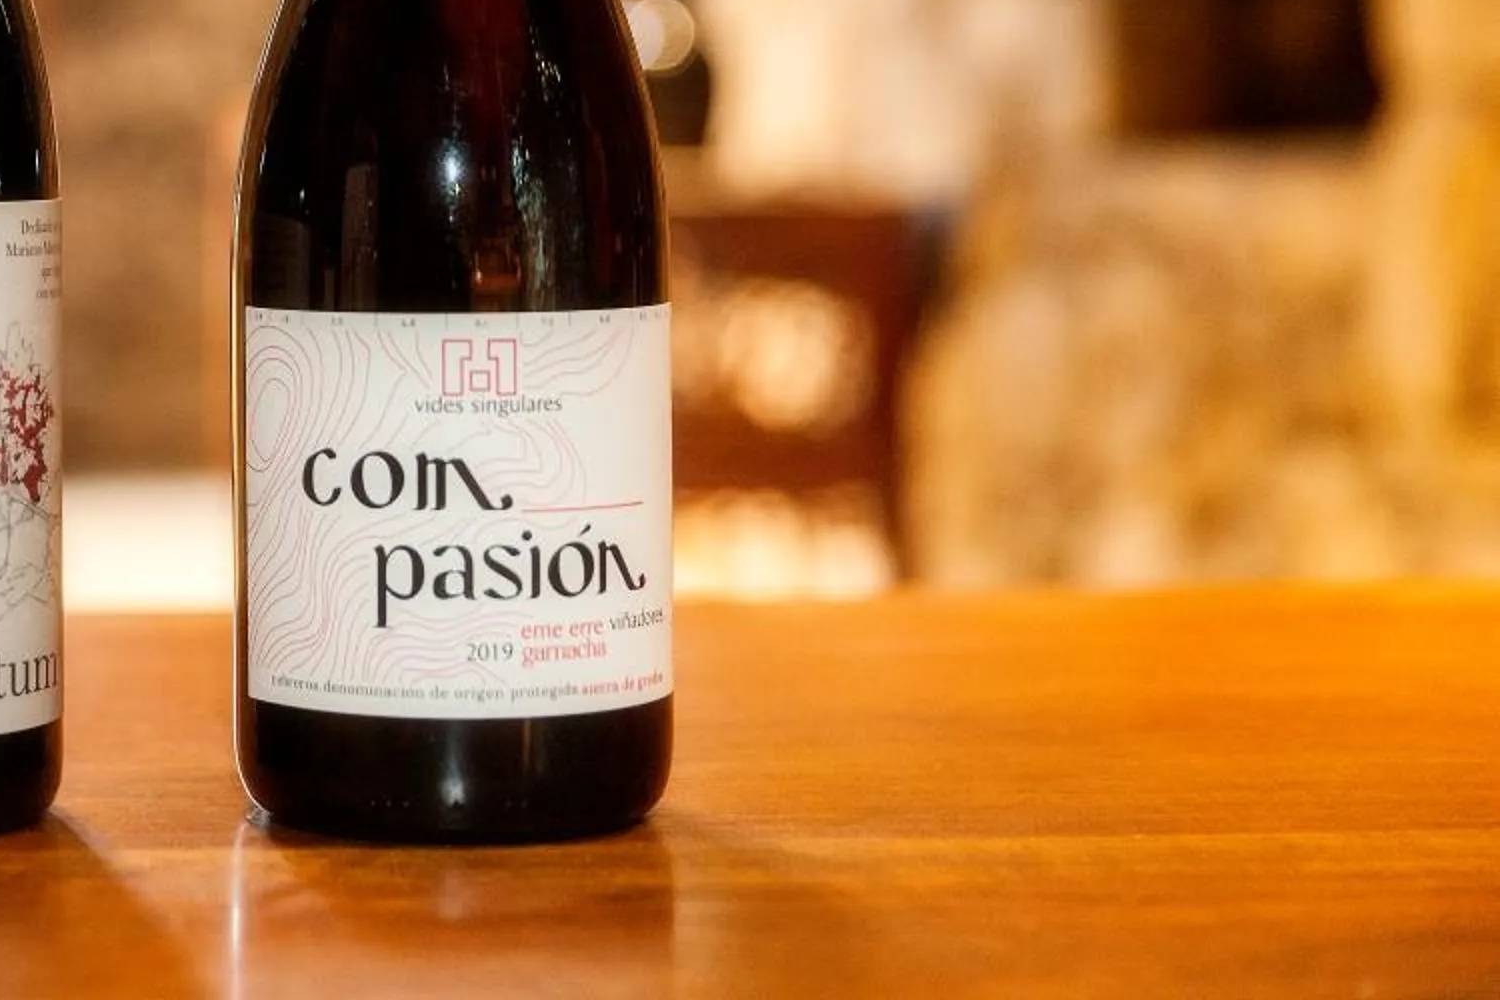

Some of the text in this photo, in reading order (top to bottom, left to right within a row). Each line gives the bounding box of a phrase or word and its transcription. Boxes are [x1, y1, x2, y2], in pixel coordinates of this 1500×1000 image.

[414, 394, 563, 418] vides singulares
[302, 447, 514, 511] com
[374, 523, 647, 628] pasión
[520, 624, 563, 640] eme
[569, 620, 605, 637] erre
[466, 639, 608, 669] 2019 garnacha
[429, 685, 450, 700] de
[453, 686, 505, 703] origen
[510, 679, 579, 704] protegida
